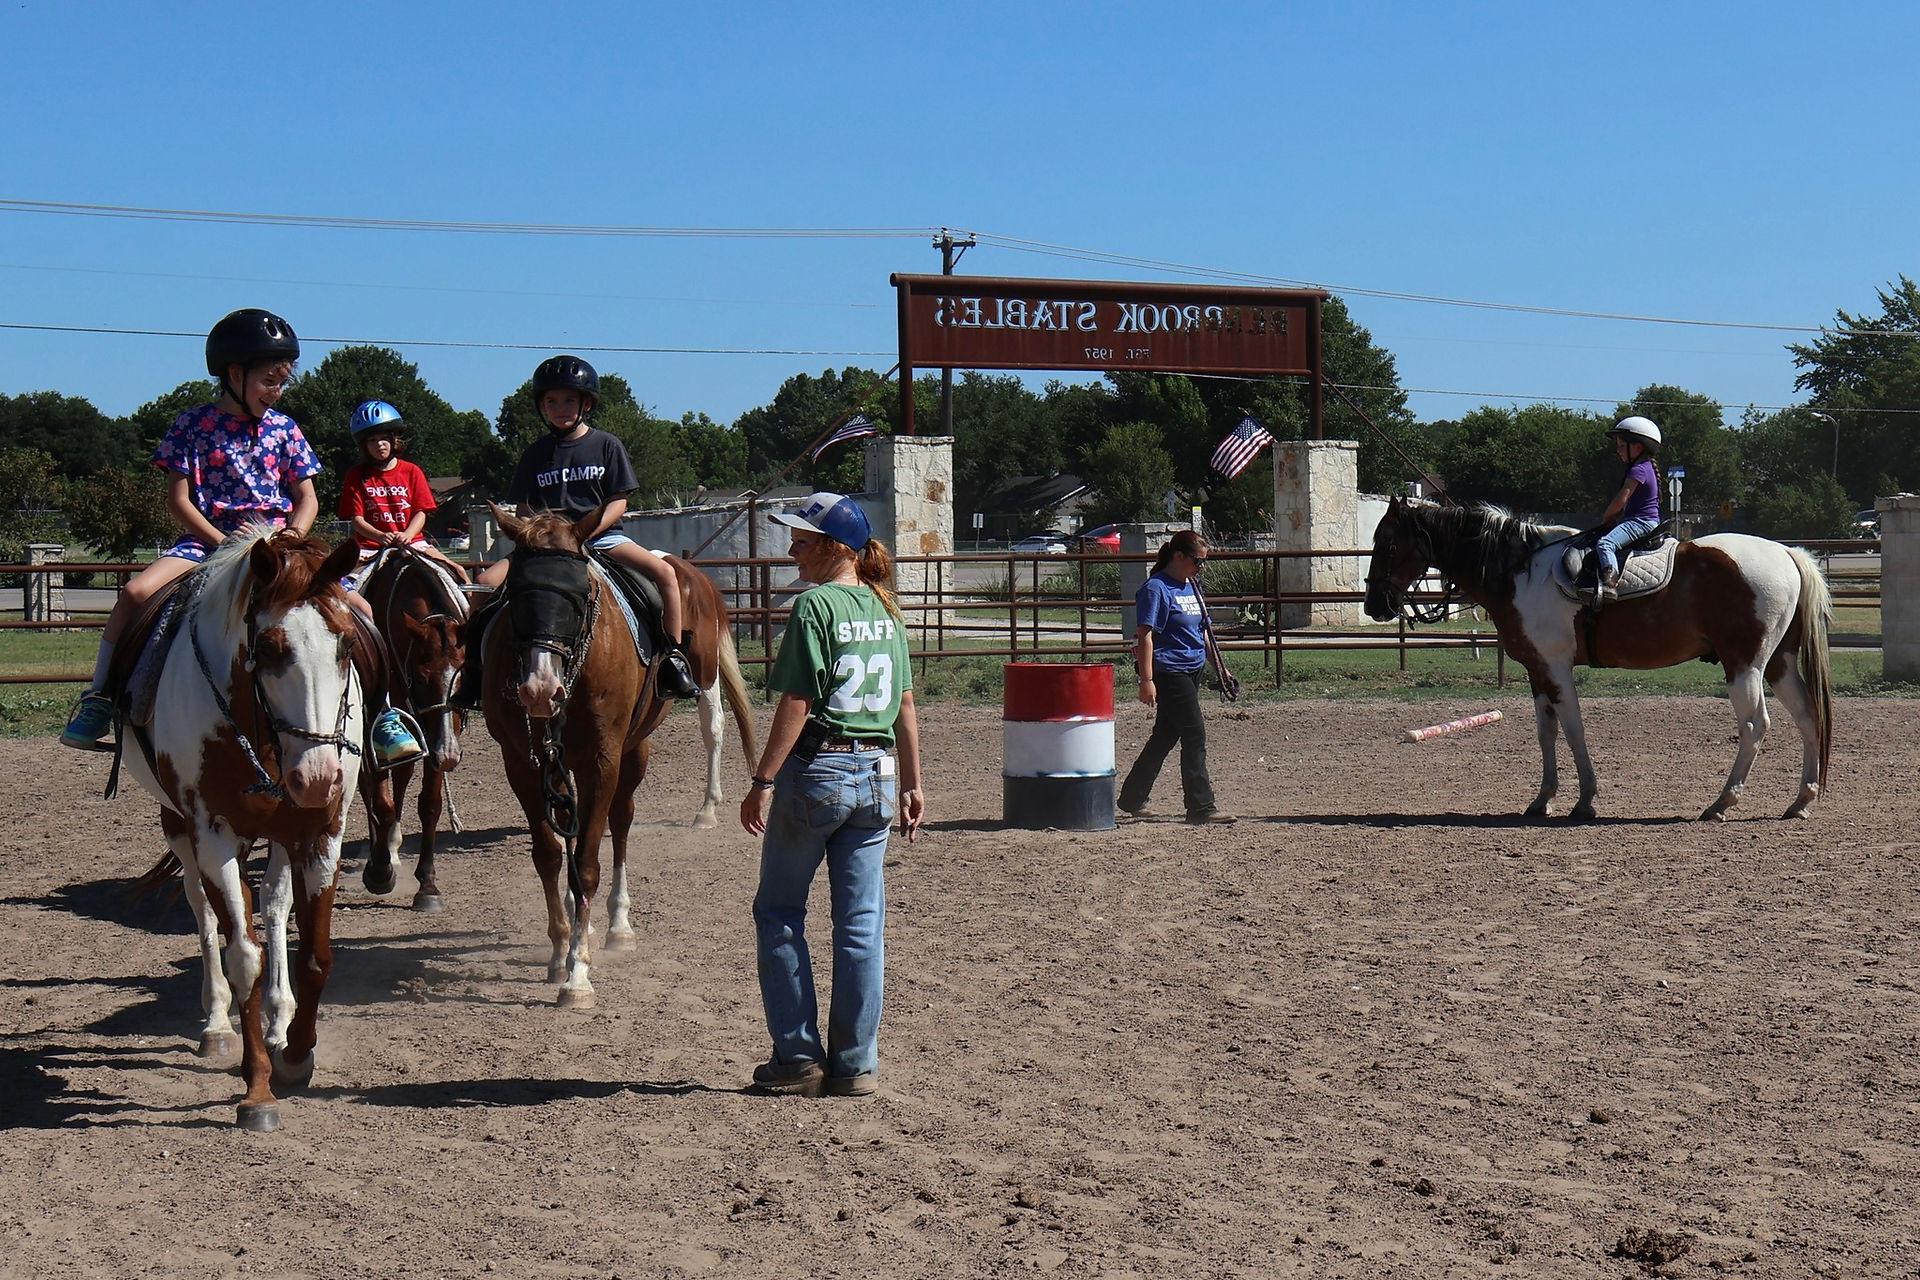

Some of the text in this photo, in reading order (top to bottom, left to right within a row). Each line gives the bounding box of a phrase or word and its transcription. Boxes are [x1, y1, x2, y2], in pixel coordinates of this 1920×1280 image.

[537, 465, 605, 487] GOT CAMP?
[838, 619, 894, 643] STAFF
[825, 653, 893, 712] 23
